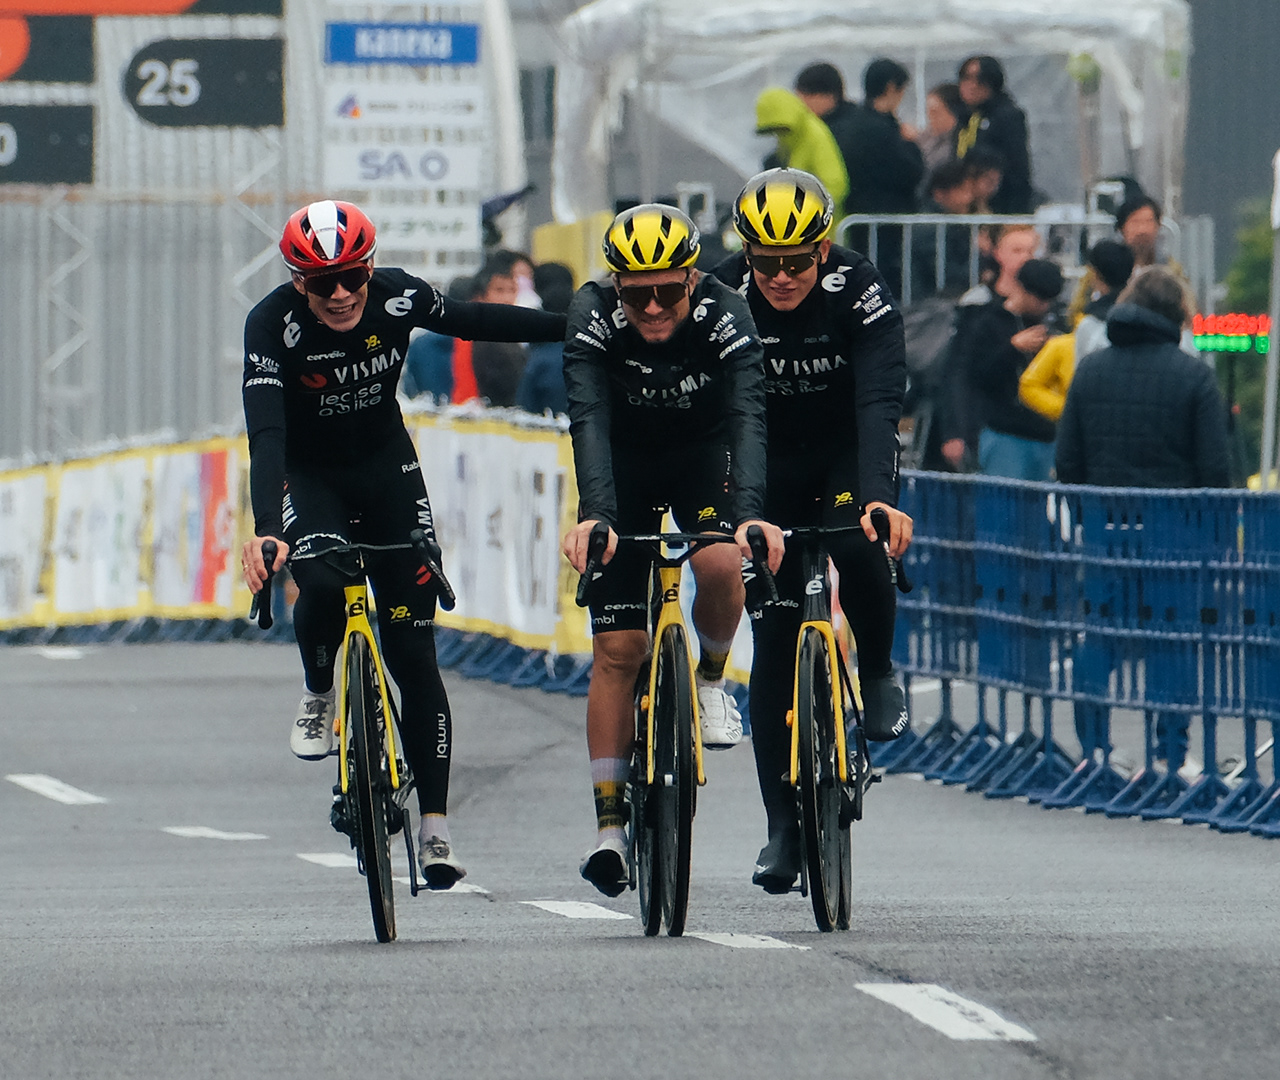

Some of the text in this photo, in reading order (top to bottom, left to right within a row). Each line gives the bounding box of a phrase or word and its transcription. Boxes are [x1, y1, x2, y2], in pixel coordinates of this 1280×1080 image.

[136, 58, 201, 106] 25
[245, 377, 284, 388] SRAM
[334, 347, 402, 384] VISMA
[770, 354, 848, 376] VISMA
[436, 713, 449, 759] nimbl
